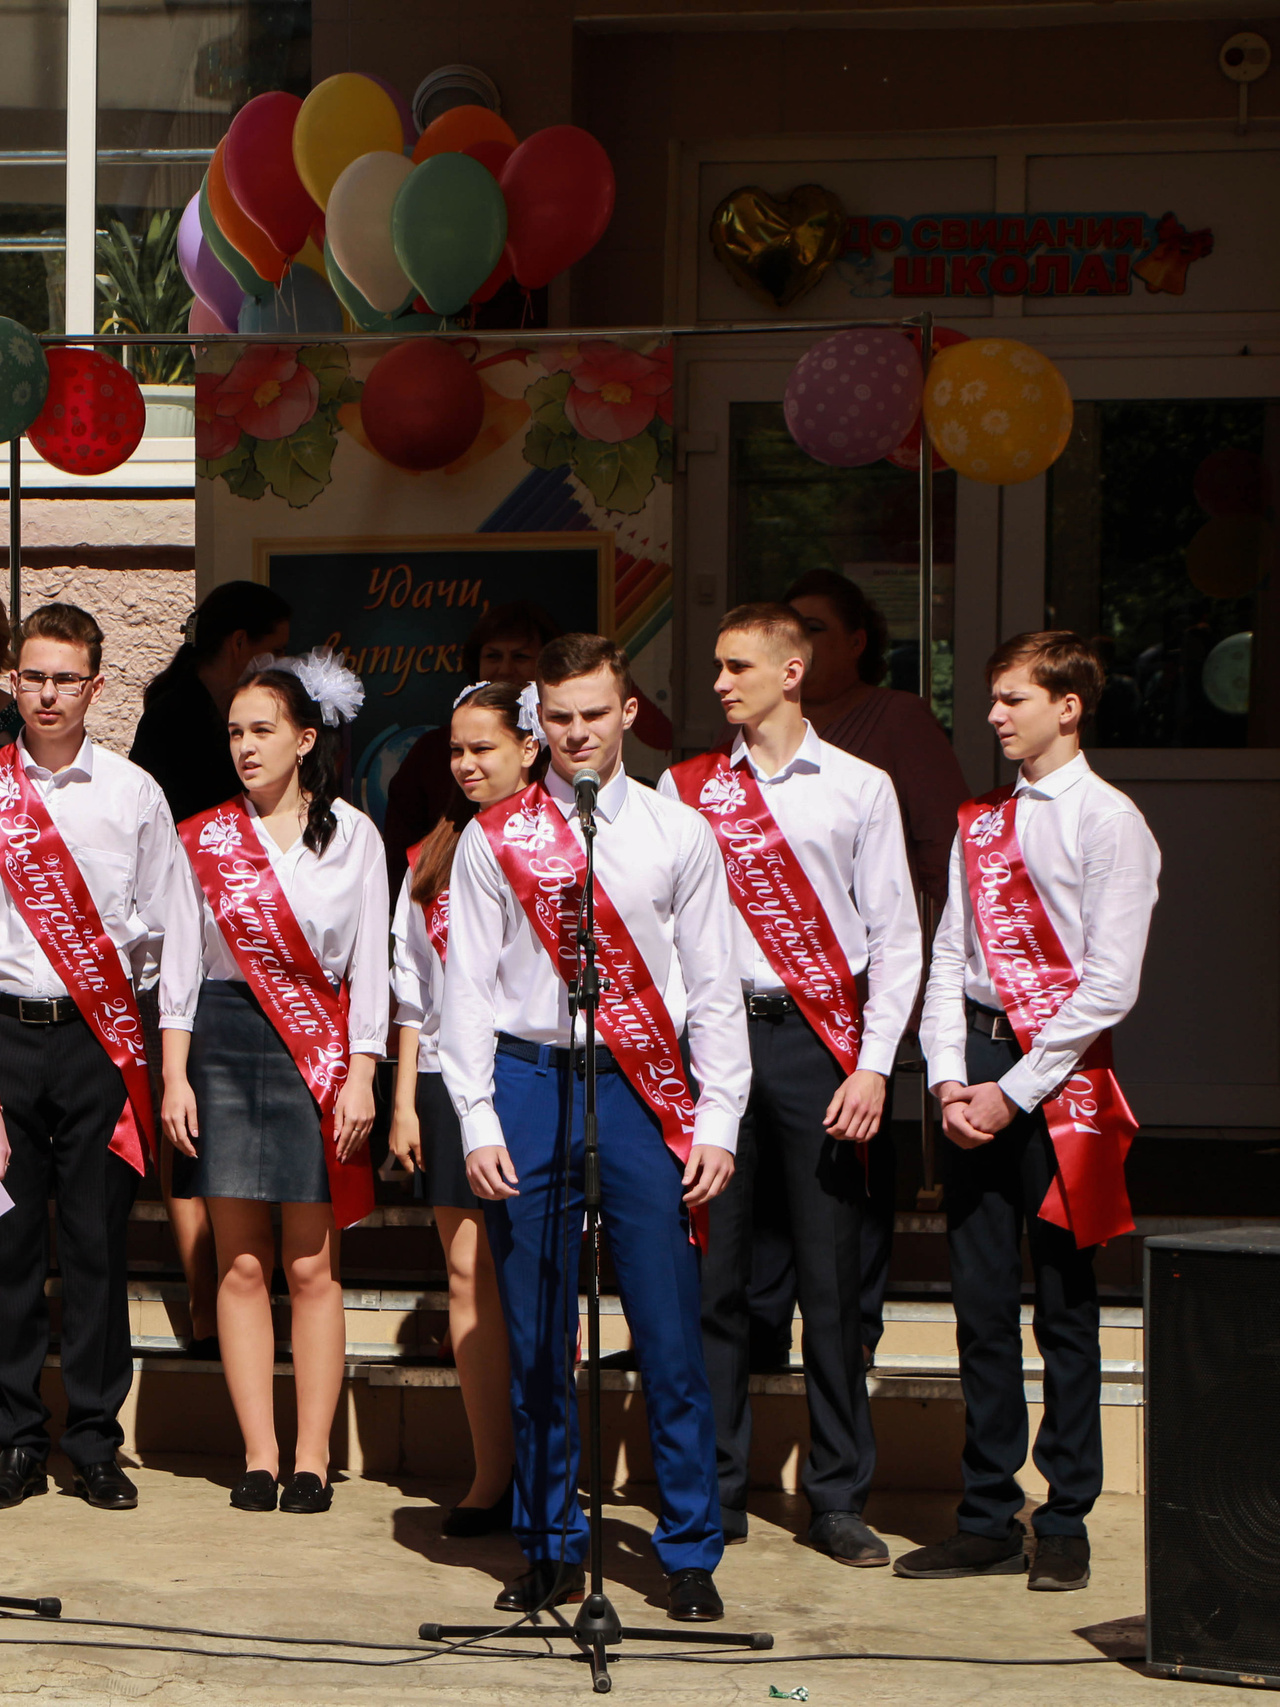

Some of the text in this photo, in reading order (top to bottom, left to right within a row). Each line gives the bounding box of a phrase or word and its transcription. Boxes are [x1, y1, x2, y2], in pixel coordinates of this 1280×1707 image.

[840, 216, 1152, 258] ДО СВИДАНИЯ,
[893, 253, 1131, 296] ШКОЛА!
[363, 563, 490, 617] Удачи,
[0, 814, 147, 1067] Выпускник 2021
[42, 854, 105, 961] Хрипачев Илья
[219, 860, 323, 1036] Выпускник
[258, 889, 295, 962] Шашкина
[721, 818, 833, 1001] Выпускник
[761, 848, 846, 1004] Пчелкин Константин
[979, 852, 1052, 1025] Выпускни
[611, 960, 671, 1054] Константин
[644, 1058, 696, 1134] 2021
